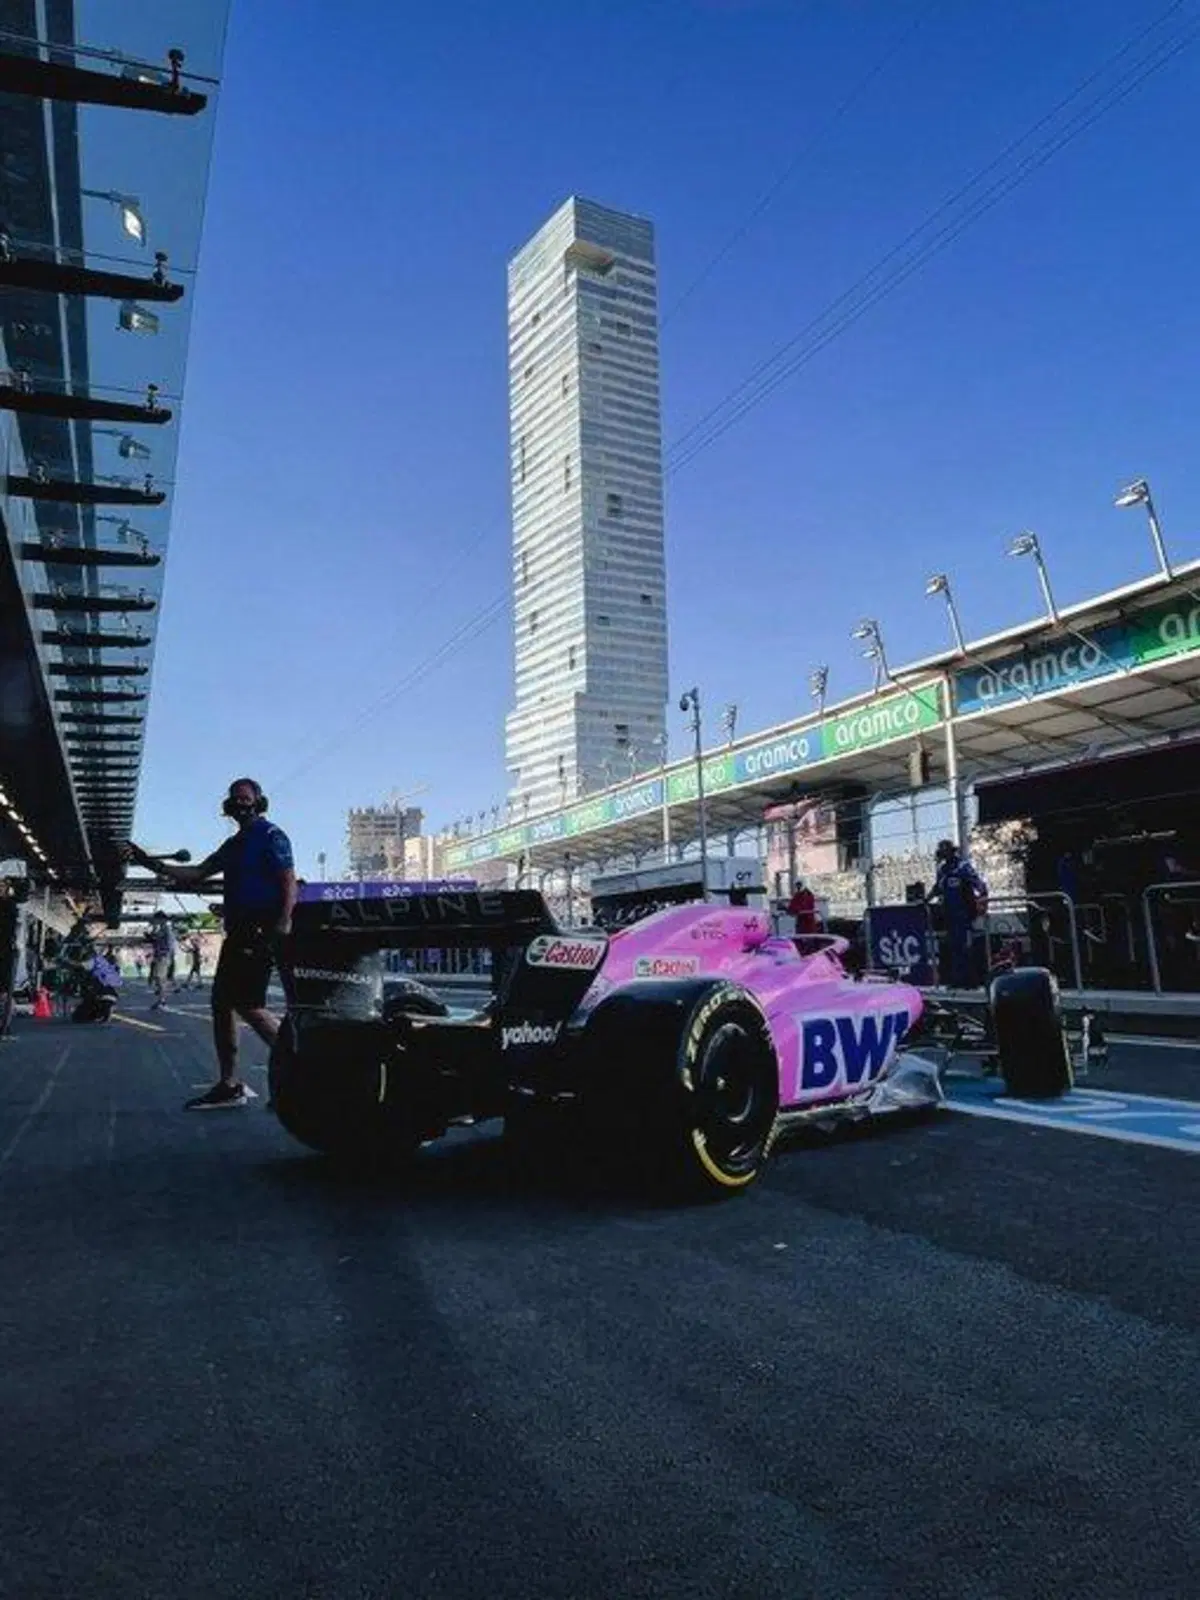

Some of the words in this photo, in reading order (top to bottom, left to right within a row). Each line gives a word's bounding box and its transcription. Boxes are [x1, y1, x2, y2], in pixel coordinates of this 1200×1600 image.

[976, 643, 1099, 700] aramco
[834, 699, 920, 746] aramco
[745, 737, 810, 774] aramco
[331, 891, 505, 921] ALPINE
[546, 941, 601, 966] Castrol
[502, 1020, 562, 1050] yahoo!
